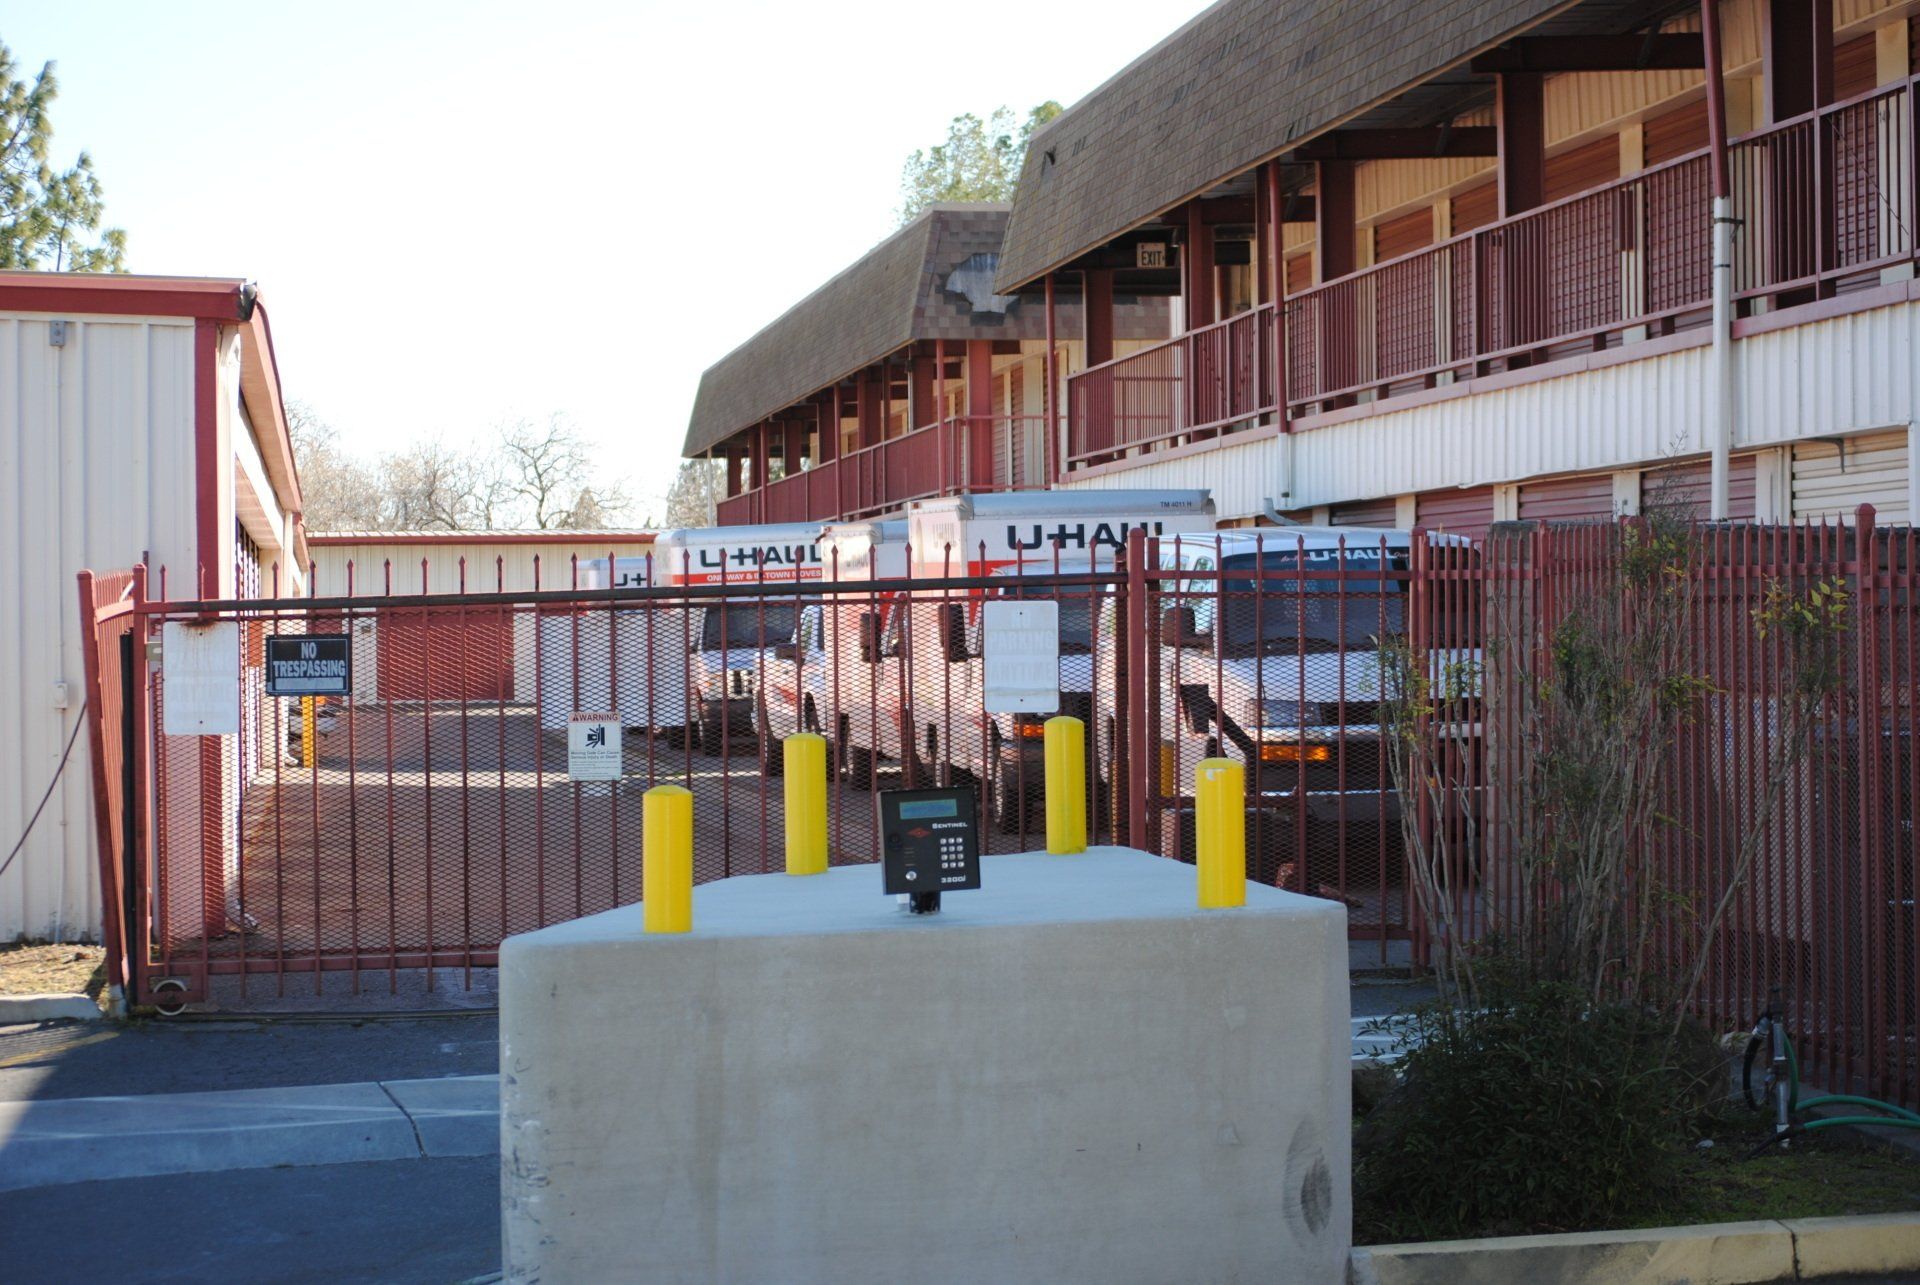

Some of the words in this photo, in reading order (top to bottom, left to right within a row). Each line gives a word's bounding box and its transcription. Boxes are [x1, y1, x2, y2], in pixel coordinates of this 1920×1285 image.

[1141, 251, 1162, 266] EXIT
[700, 544, 822, 567] U-HAUL
[706, 574, 722, 582] ON
[726, 572, 745, 581] WAY
[301, 642, 317, 659] NO
[272, 660, 346, 677] TRESPASSING
[579, 713, 618, 721] WARNING
